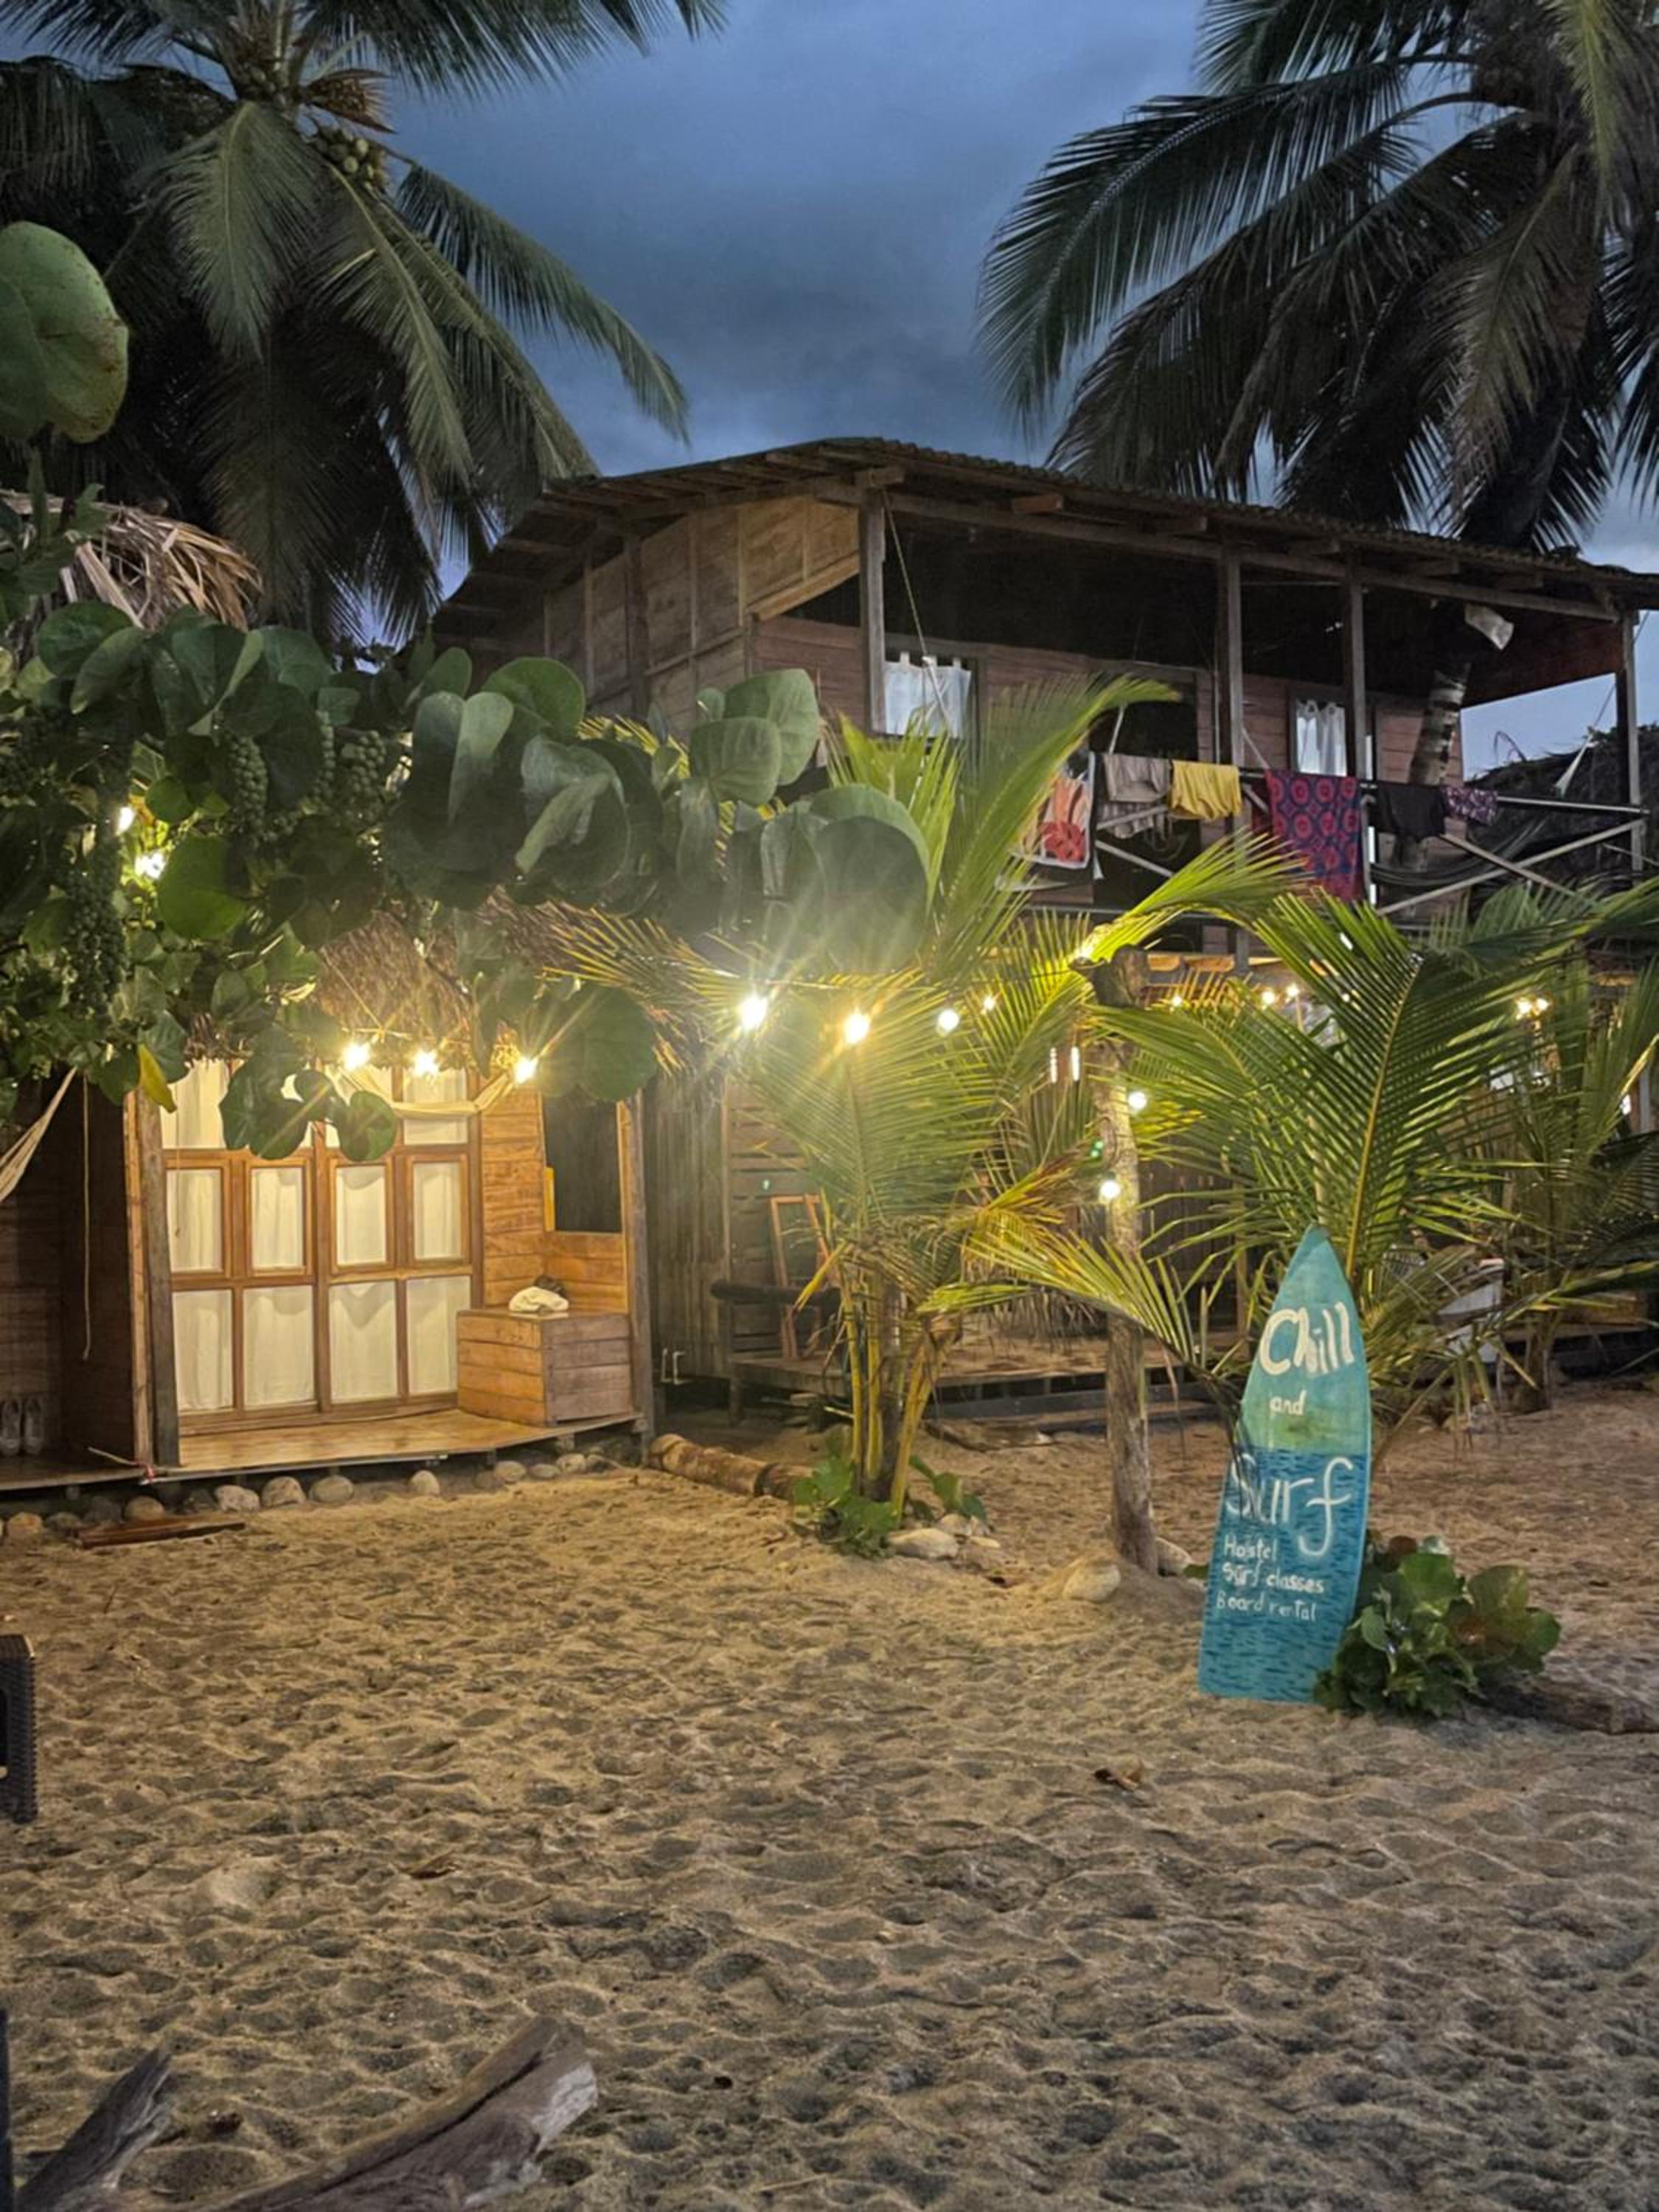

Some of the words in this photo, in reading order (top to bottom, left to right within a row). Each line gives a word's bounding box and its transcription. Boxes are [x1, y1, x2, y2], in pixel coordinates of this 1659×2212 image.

[1260, 1302, 1354, 1375] Chill
[1269, 1389, 1307, 1416] and
[1225, 1453, 1352, 1556] Surf
[1225, 1534, 1276, 1560] Hostel
[1266, 1568, 1324, 1593] classes
